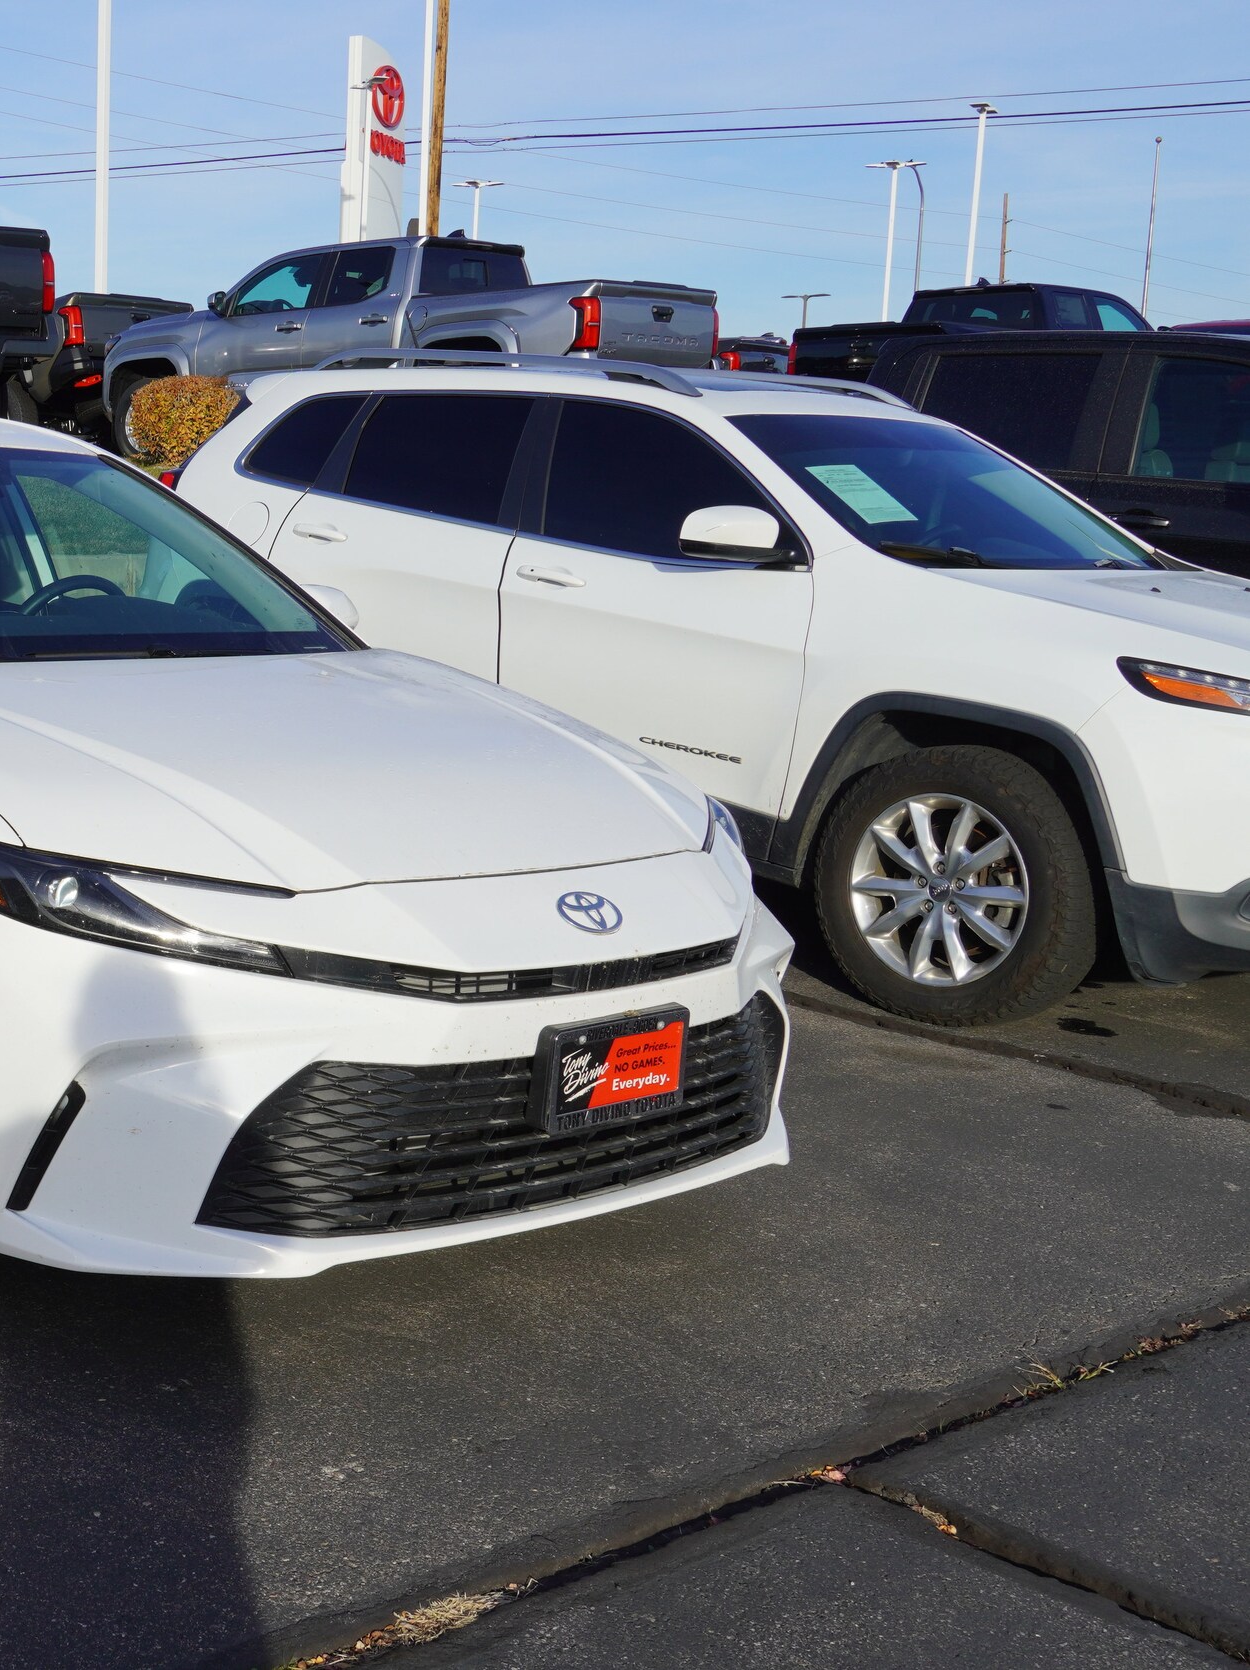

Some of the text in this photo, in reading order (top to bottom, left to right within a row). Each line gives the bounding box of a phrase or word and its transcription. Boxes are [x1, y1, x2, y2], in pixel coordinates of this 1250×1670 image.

[362, 128, 406, 165] OYOTA
[621, 332, 700, 347] TACOMA
[638, 735, 742, 765] CHEROKEE
[561, 1047, 593, 1077] Tony
[614, 1056, 666, 1074] NO GAMES.
[616, 1046, 642, 1058] Great
[560, 1061, 610, 1095] Divino
[611, 1072, 671, 1092] Everyday.
[556, 1092, 676, 1132] TONY DIVINO TOYOTA
